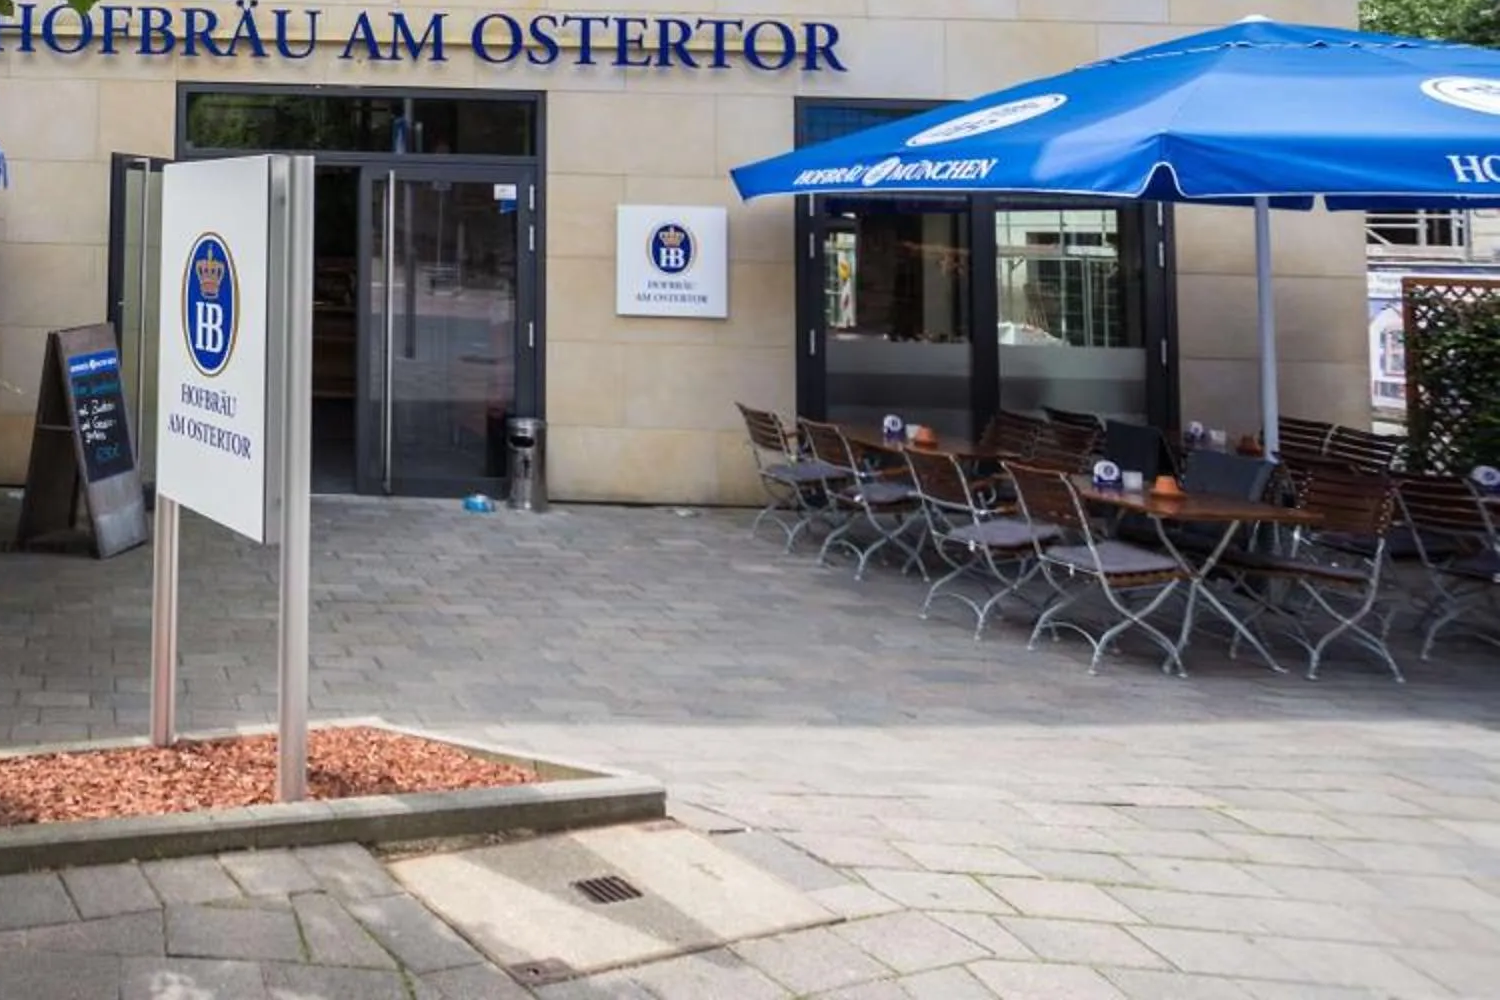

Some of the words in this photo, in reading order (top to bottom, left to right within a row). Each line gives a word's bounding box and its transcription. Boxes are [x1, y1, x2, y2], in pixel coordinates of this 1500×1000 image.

[338, 10, 449, 62] AM
[471, 13, 848, 72] OSTERTOR
[889, 158, 997, 181] MÜNCHEN
[659, 247, 685, 268] HB
[195, 302, 223, 353] HB
[181, 382, 237, 418] HOFBRÄU
[168, 413, 186, 435] AM
[186, 421, 251, 460] OSTERTOR
